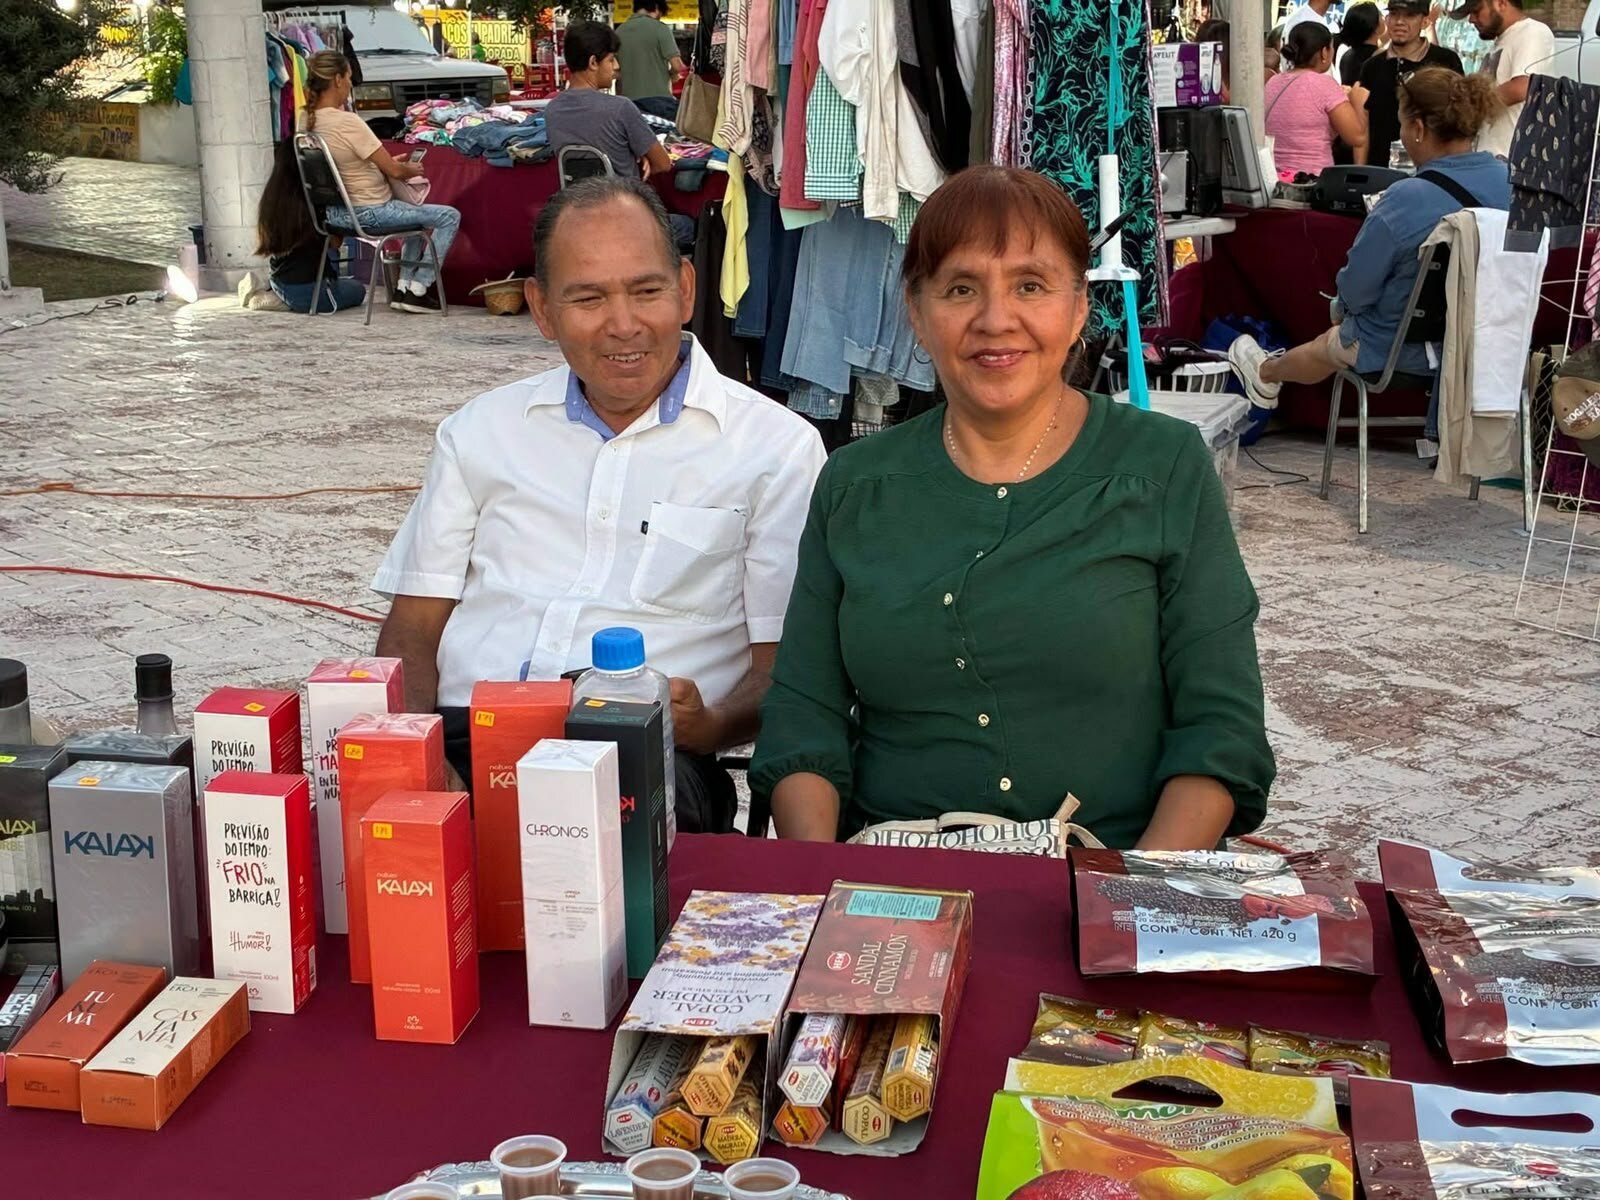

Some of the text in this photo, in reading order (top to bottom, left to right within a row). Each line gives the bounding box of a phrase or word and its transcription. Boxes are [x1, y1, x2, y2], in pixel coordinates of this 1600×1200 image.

[444, 22, 467, 45] COS
[211, 739, 255, 757] PREVISÃO
[212, 759, 224, 772] DO
[319, 777, 329, 787] EN
[224, 822, 269, 841] PREVISÃO
[526, 823, 589, 839] CHRONOS
[64, 831, 154, 859] KAIAK
[225, 843, 237, 856] DO
[222, 861, 276, 887] FRIO NA
[377, 879, 433, 897] KAIAK
[229, 887, 281, 908] BARRIGA!
[1261, 927, 1284, 939] 420
[1288, 931, 1297, 942] g
[851, 941, 882, 985] SANDAL
[873, 933, 909, 995] CINNAMON
[83, 990, 115, 1004] TU
[652, 989, 774, 1003] LAVENDER
[671, 1002, 744, 1014] COPAL
[683, 1018, 717, 1026] HEM
[609, 1122, 649, 1138] LAVENDER
[861, 1105, 870, 1139] COPAL
[1210, 1130, 1286, 1150] ganoderma
